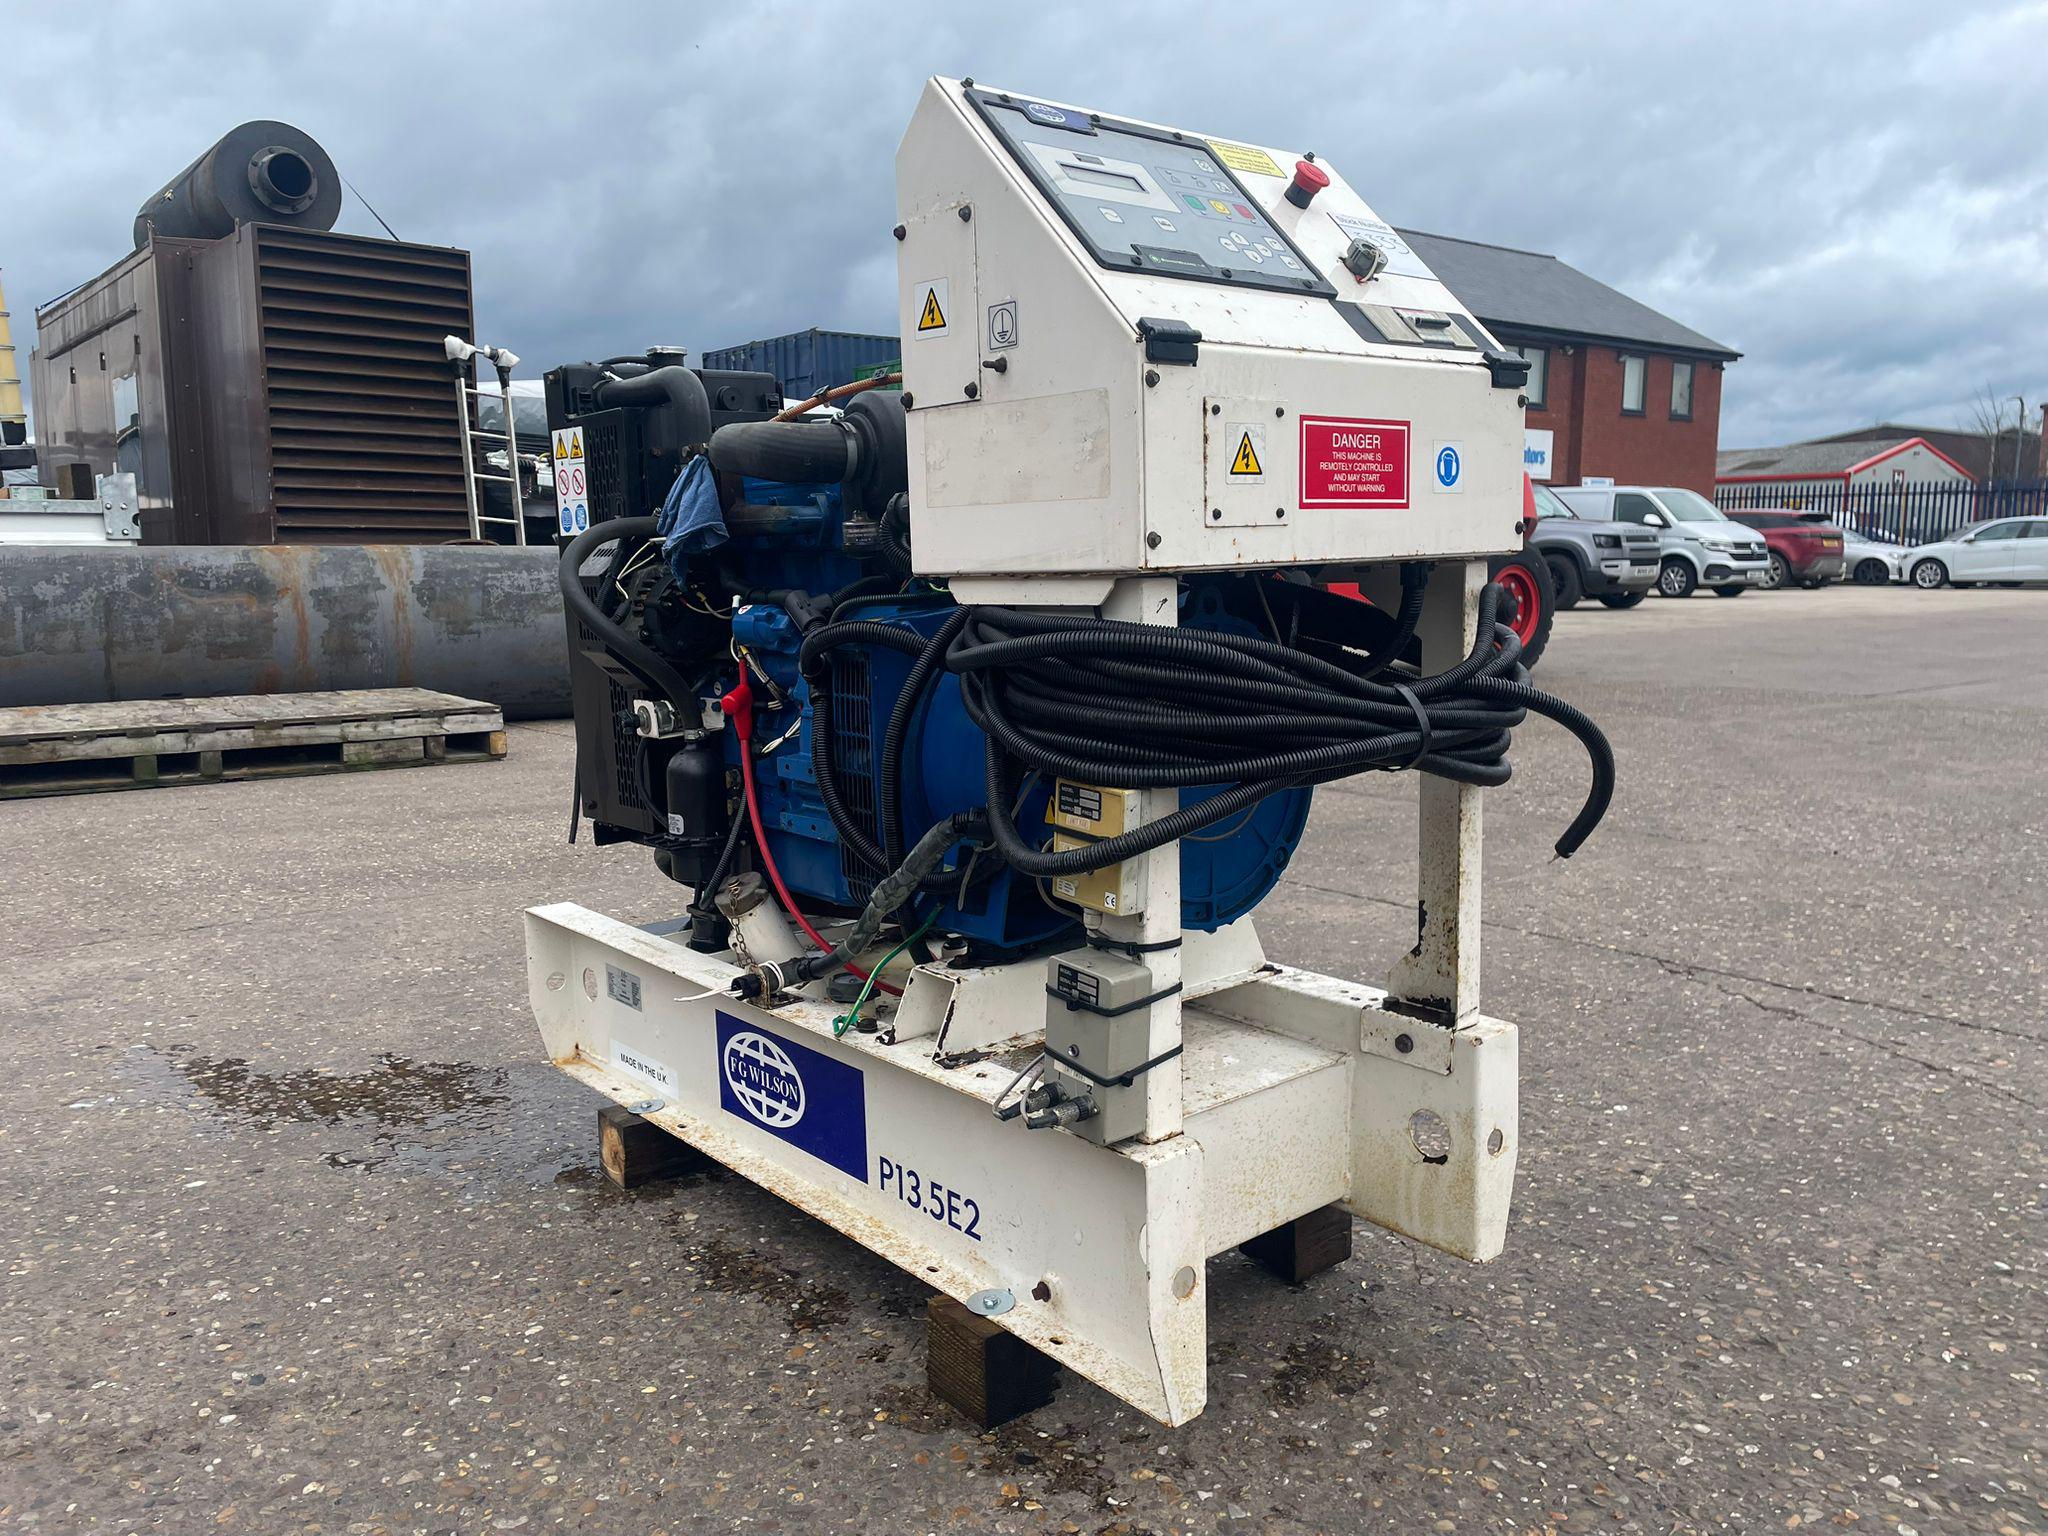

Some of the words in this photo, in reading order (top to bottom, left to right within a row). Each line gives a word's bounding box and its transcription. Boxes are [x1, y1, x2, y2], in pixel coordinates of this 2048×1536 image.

[1332, 433, 1381, 449] DANGER
[1332, 451, 1346, 460] THIS
[1347, 452, 1374, 461] MACHINE
[1375, 452, 1382, 461] IS
[1320, 461, 1352, 471] REMOTELY
[1353, 463, 1394, 472] CONTROLLED
[1333, 473, 1347, 481] AND
[1347, 473, 1360, 481] MAY
[1361, 474, 1380, 482] START
[1328, 484, 1356, 492] WITHOUT
[1357, 484, 1385, 493] WARNING
[620, 1053, 637, 1069] MADE
[637, 1061, 644, 1072] IN
[644, 1065, 656, 1079] THE
[730, 1056, 738, 1073] F
[738, 1061, 747, 1078] G
[749, 1065, 798, 1102] WILSON
[879, 1155, 982, 1242] P13.5E2
